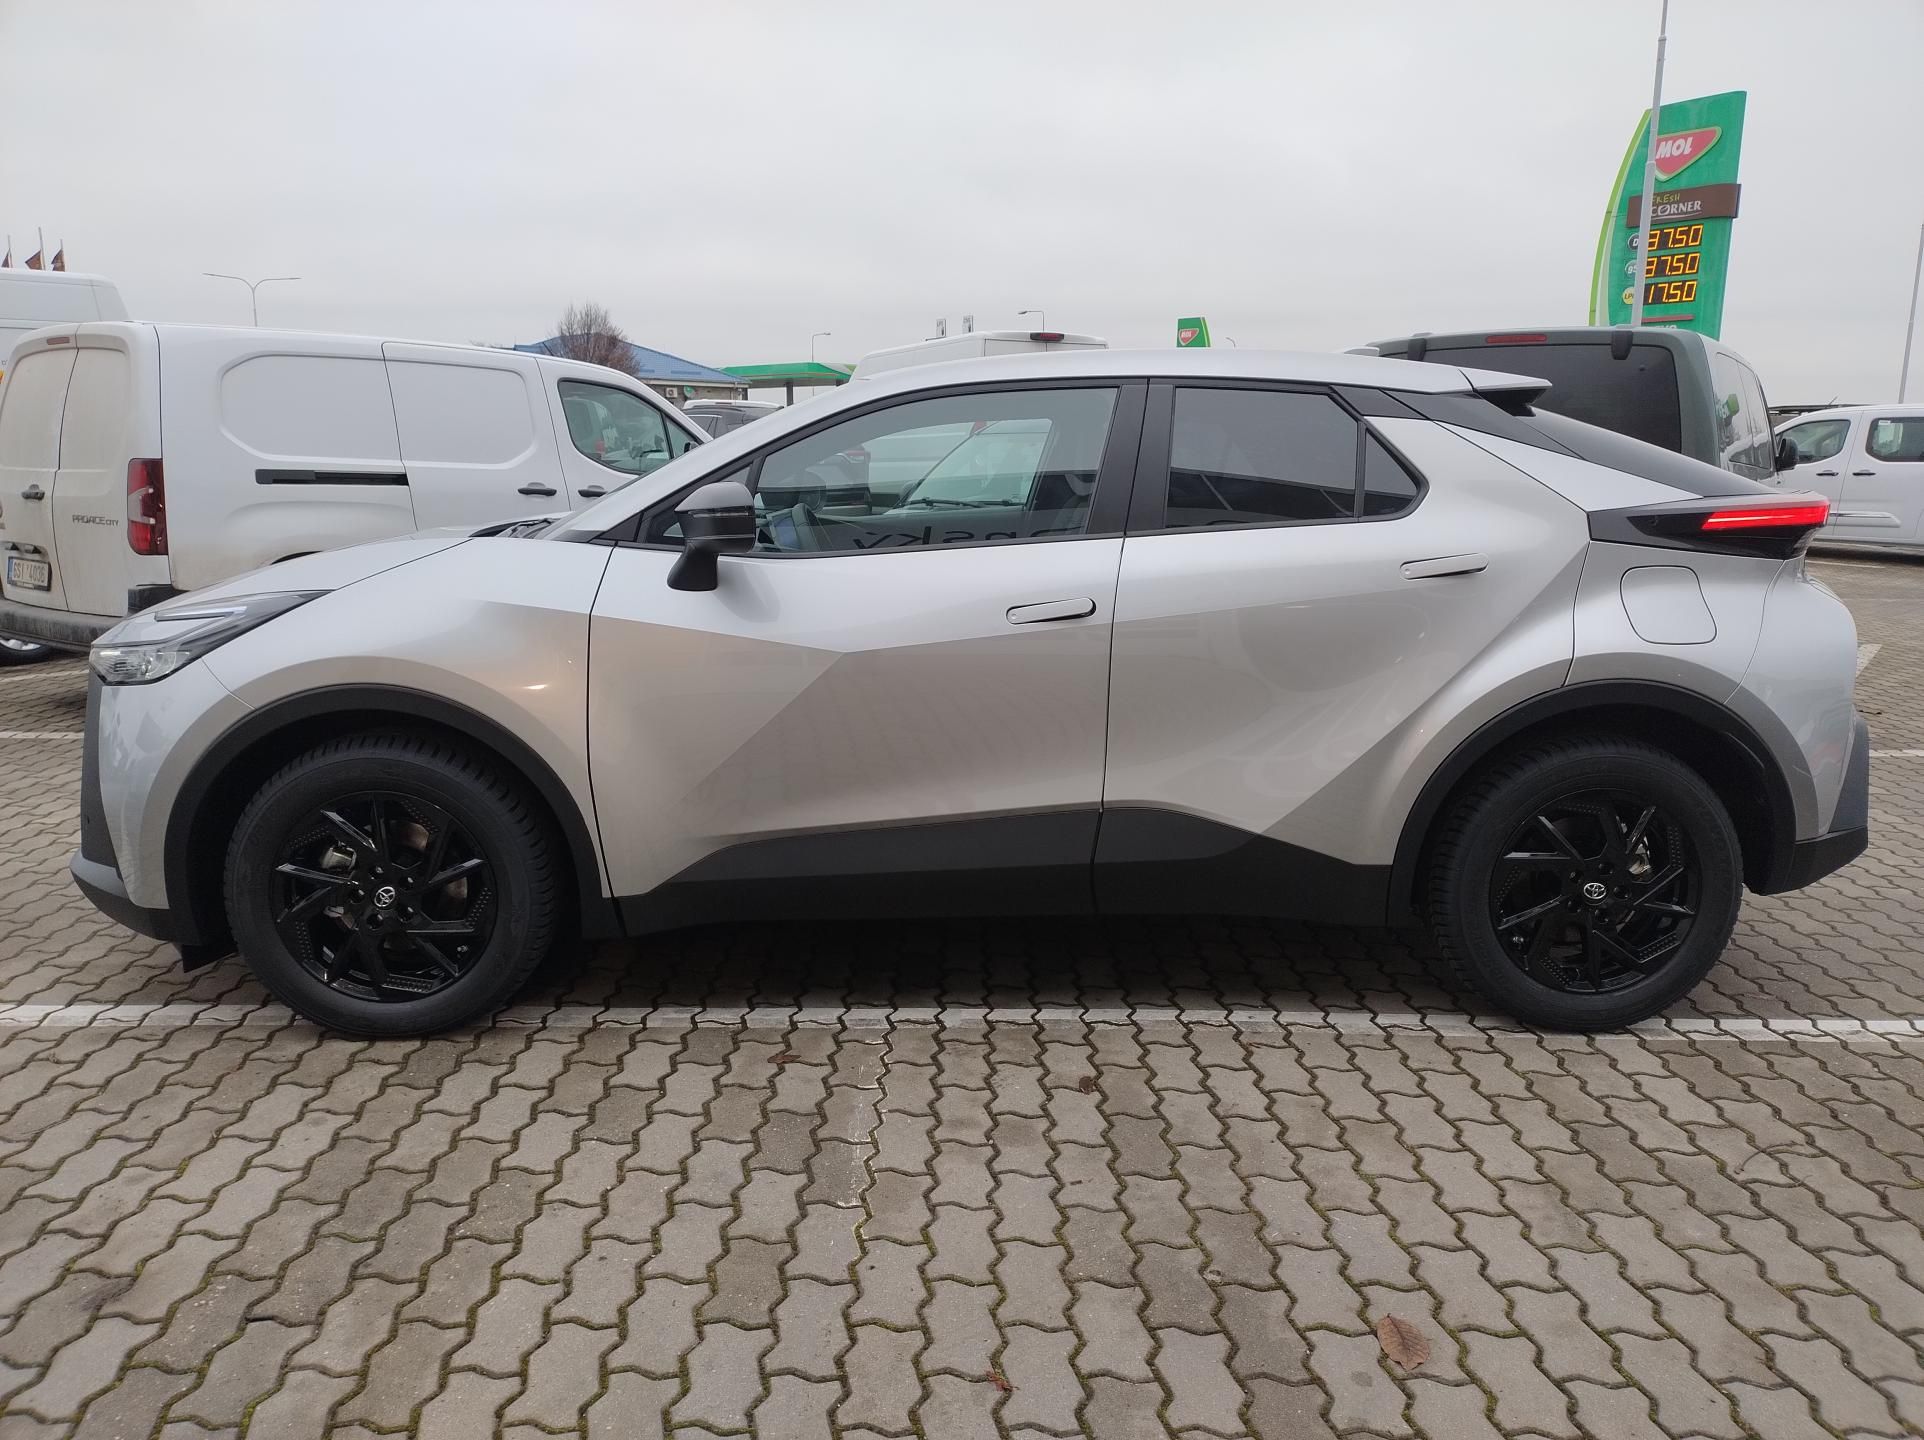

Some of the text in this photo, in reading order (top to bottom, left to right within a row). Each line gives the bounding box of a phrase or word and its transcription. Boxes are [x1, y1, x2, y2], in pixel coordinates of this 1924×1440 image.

[1656, 137, 1693, 159] MOL
[1651, 200, 1701, 216] CORNER
[72, 514, 105, 525] PROACE
